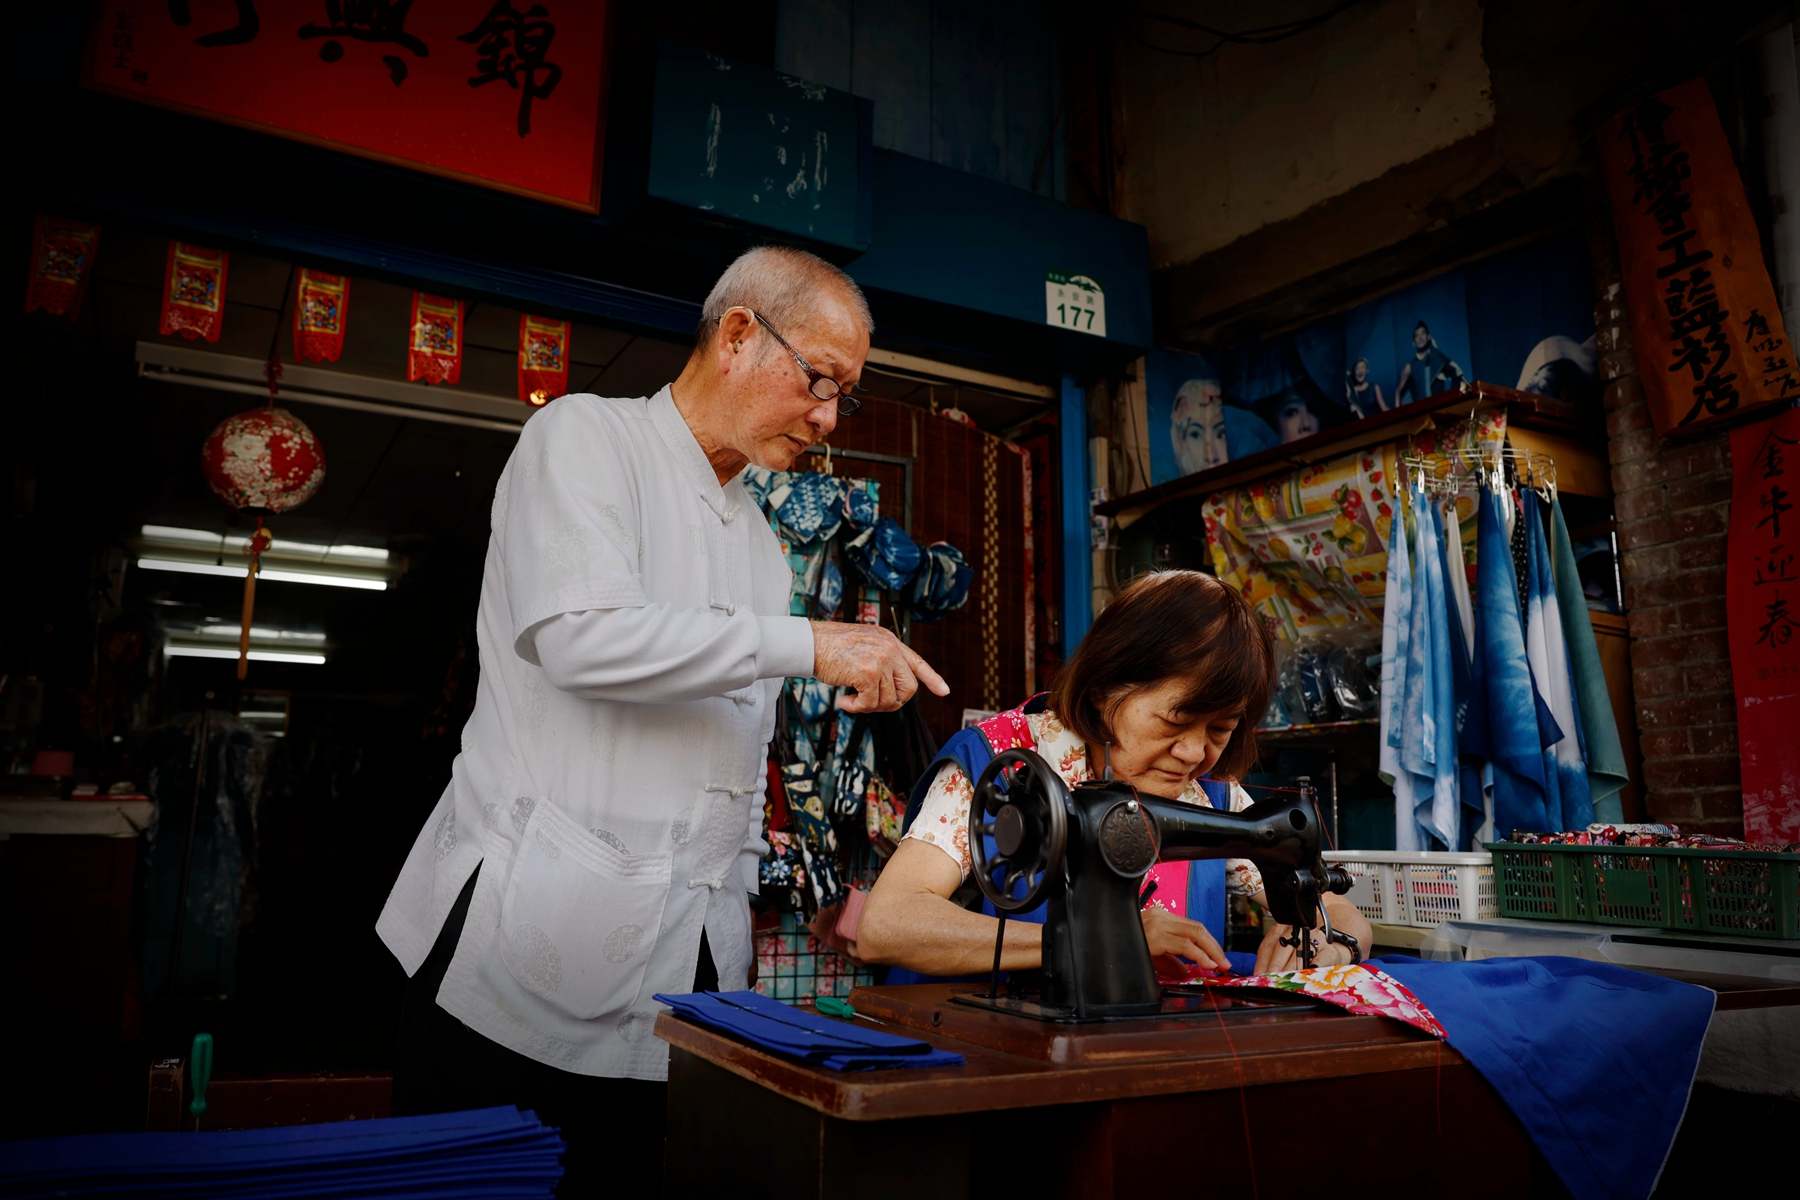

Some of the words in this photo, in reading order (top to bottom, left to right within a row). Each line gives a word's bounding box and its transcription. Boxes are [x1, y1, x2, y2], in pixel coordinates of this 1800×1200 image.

[1057, 303, 1096, 330] 177
[1616, 94, 1740, 427] 傳統手工藍衫店
[1749, 429, 1800, 650] 金牛迎春
